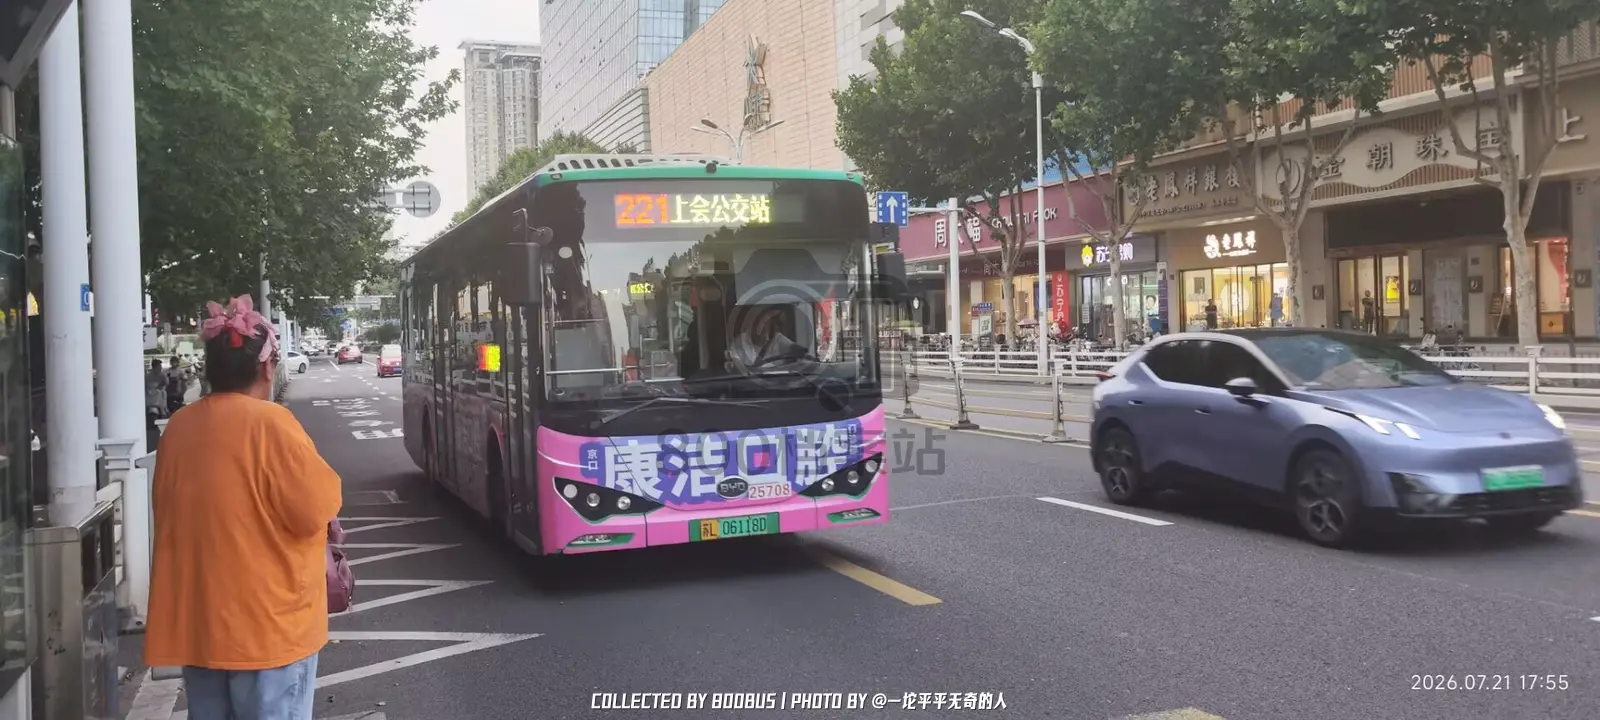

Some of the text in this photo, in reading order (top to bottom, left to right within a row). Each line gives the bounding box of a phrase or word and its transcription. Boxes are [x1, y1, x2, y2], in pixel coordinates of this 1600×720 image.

[1558, 107, 1587, 142] 上
[616, 193, 770, 224] 221 上会公交站
[935, 212, 981, 248] 周福
[1096, 242, 1134, 262] 苏购
[587, 449, 598, 471] 京口
[604, 423, 849, 499] 康洁口腔
[719, 482, 747, 494] BYD
[749, 485, 790, 498] 25708
